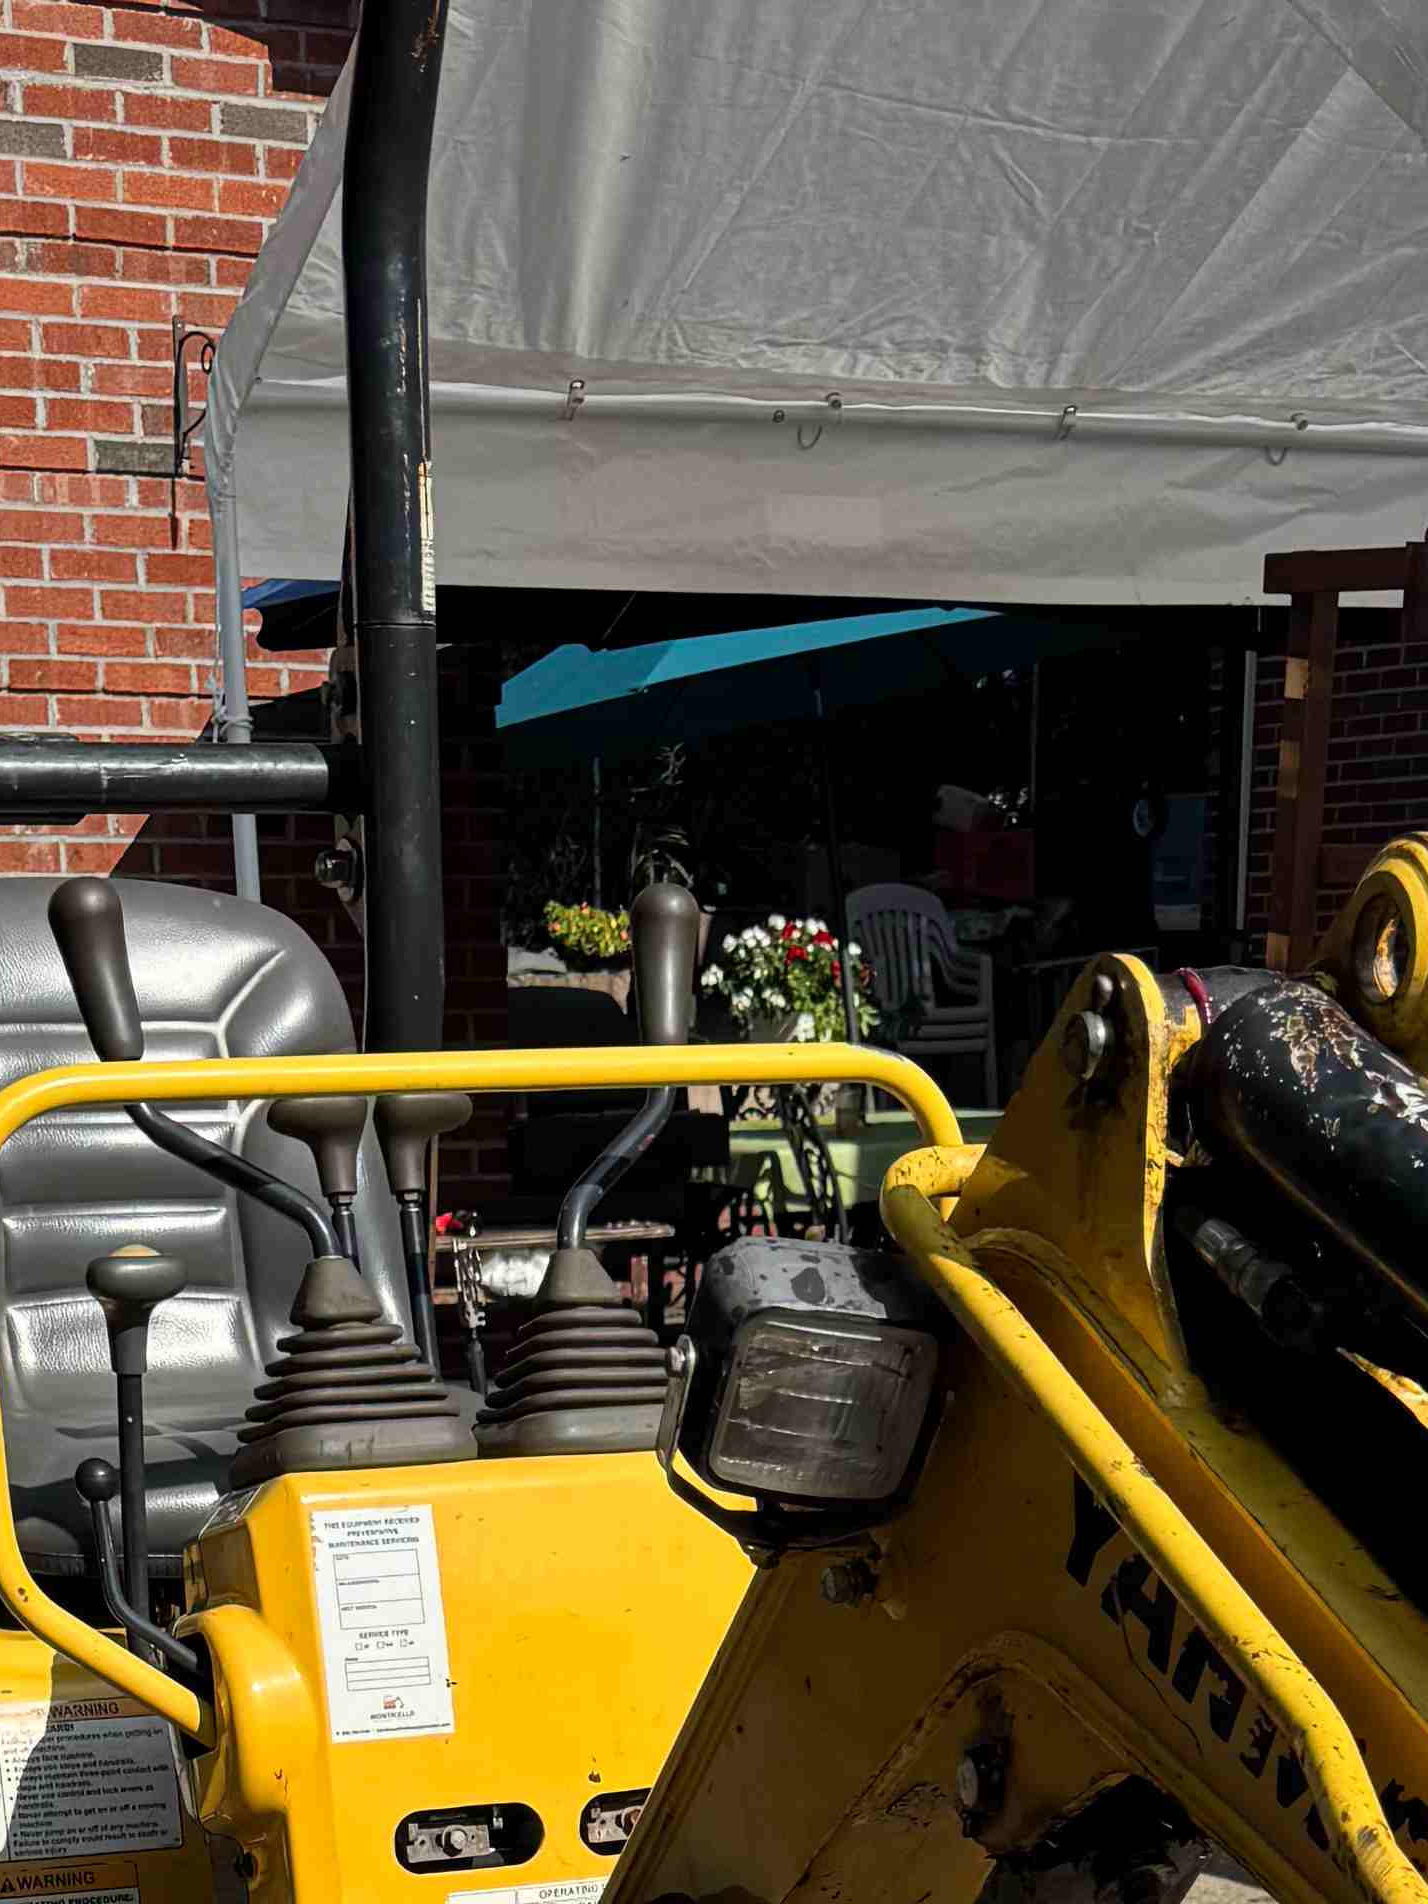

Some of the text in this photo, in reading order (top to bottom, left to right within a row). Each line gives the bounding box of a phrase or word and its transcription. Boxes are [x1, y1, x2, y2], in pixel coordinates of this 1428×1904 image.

[359, 1631, 389, 1640] SERVICE
[49, 1702, 119, 1719] WARNING
[16, 1871, 96, 1892] WARNING
